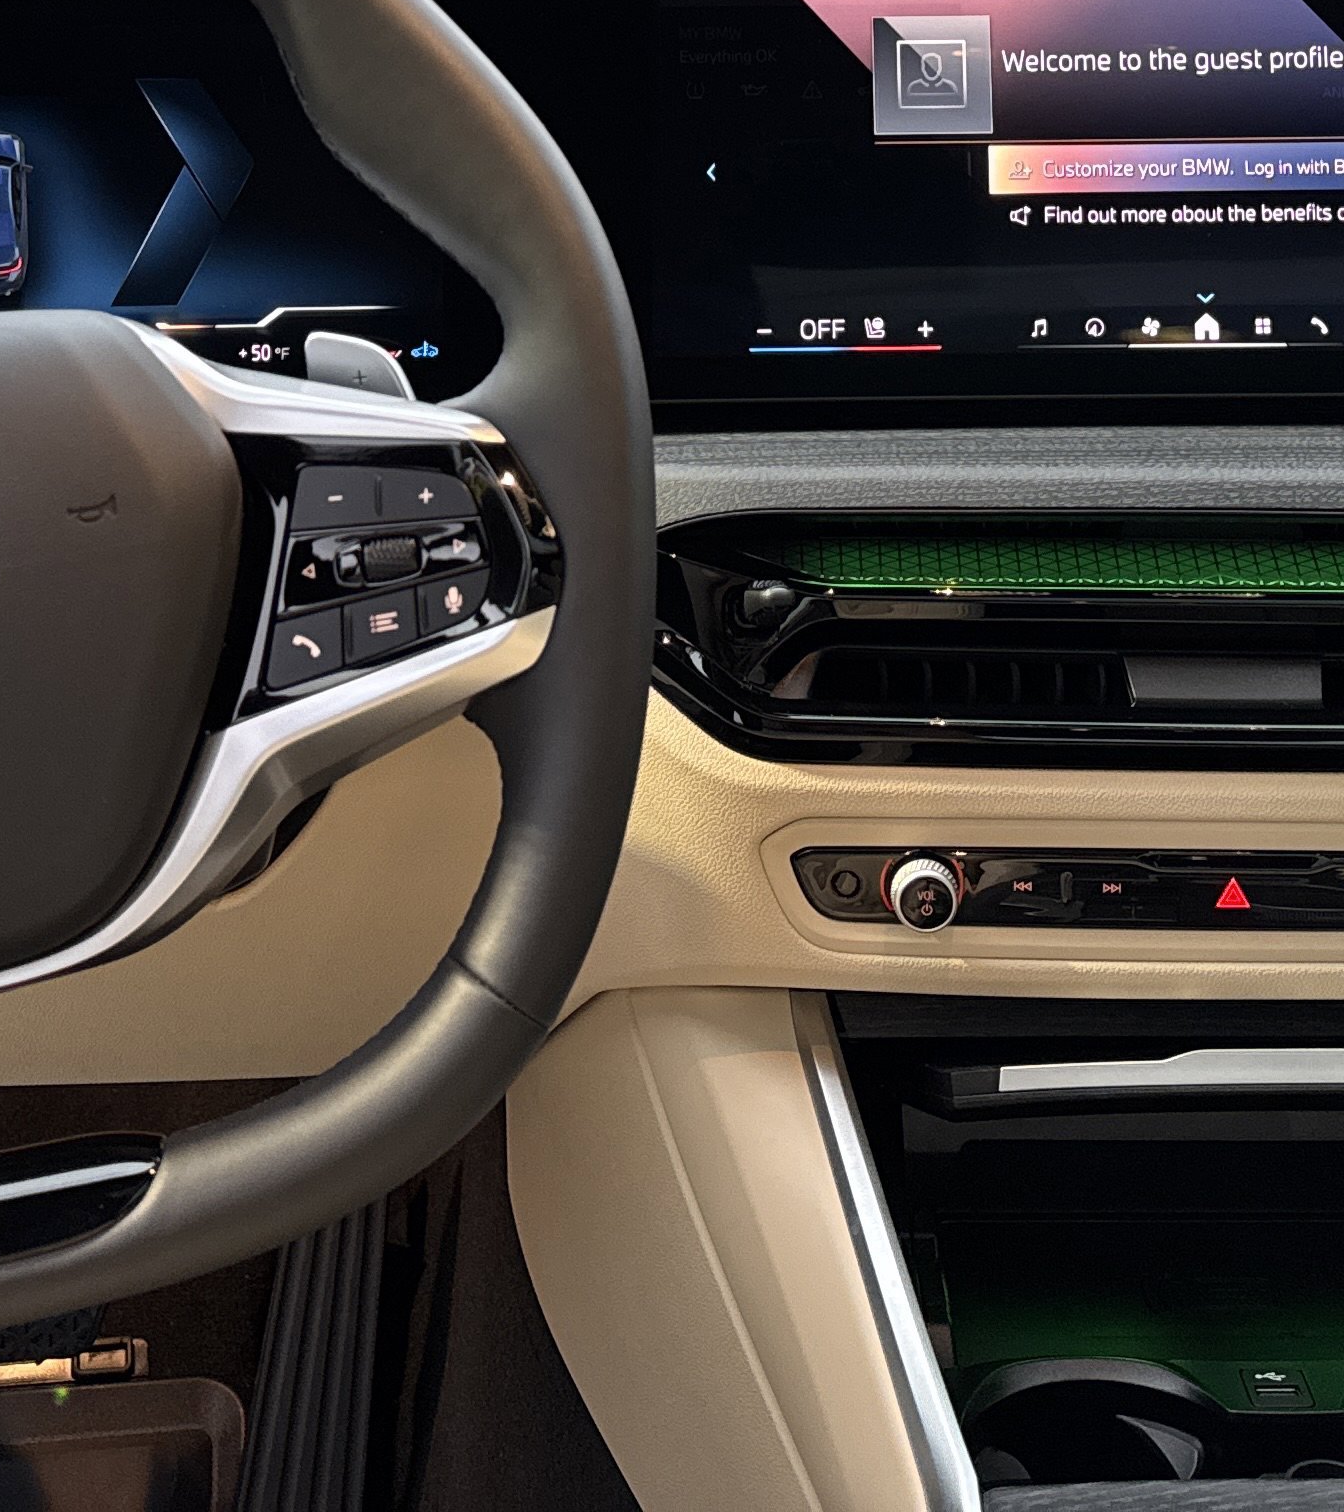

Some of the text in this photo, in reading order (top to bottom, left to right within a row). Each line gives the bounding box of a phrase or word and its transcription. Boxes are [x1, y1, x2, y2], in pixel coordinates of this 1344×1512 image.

[679, 48, 777, 66] Everything OK
[1001, 49, 1111, 73] Welcome
[1120, 51, 1141, 71] to
[1149, 48, 1186, 71] the
[1195, 48, 1262, 75] guest
[1042, 159, 1134, 178] Customize
[1137, 163, 1177, 180] your
[1182, 158, 1234, 176] BMW.
[1244, 160, 1274, 178] Log
[1279, 159, 1293, 175] in
[1296, 159, 1330, 175] with
[1044, 205, 1083, 224] Find
[1087, 207, 1117, 224] out
[1121, 208, 1167, 223] more
[1171, 204, 1224, 223] about
[1227, 204, 1256, 222] the
[1261, 202, 1333, 222] benefits
[800, 318, 846, 341] OFF
[916, 890, 936, 901] VOL
